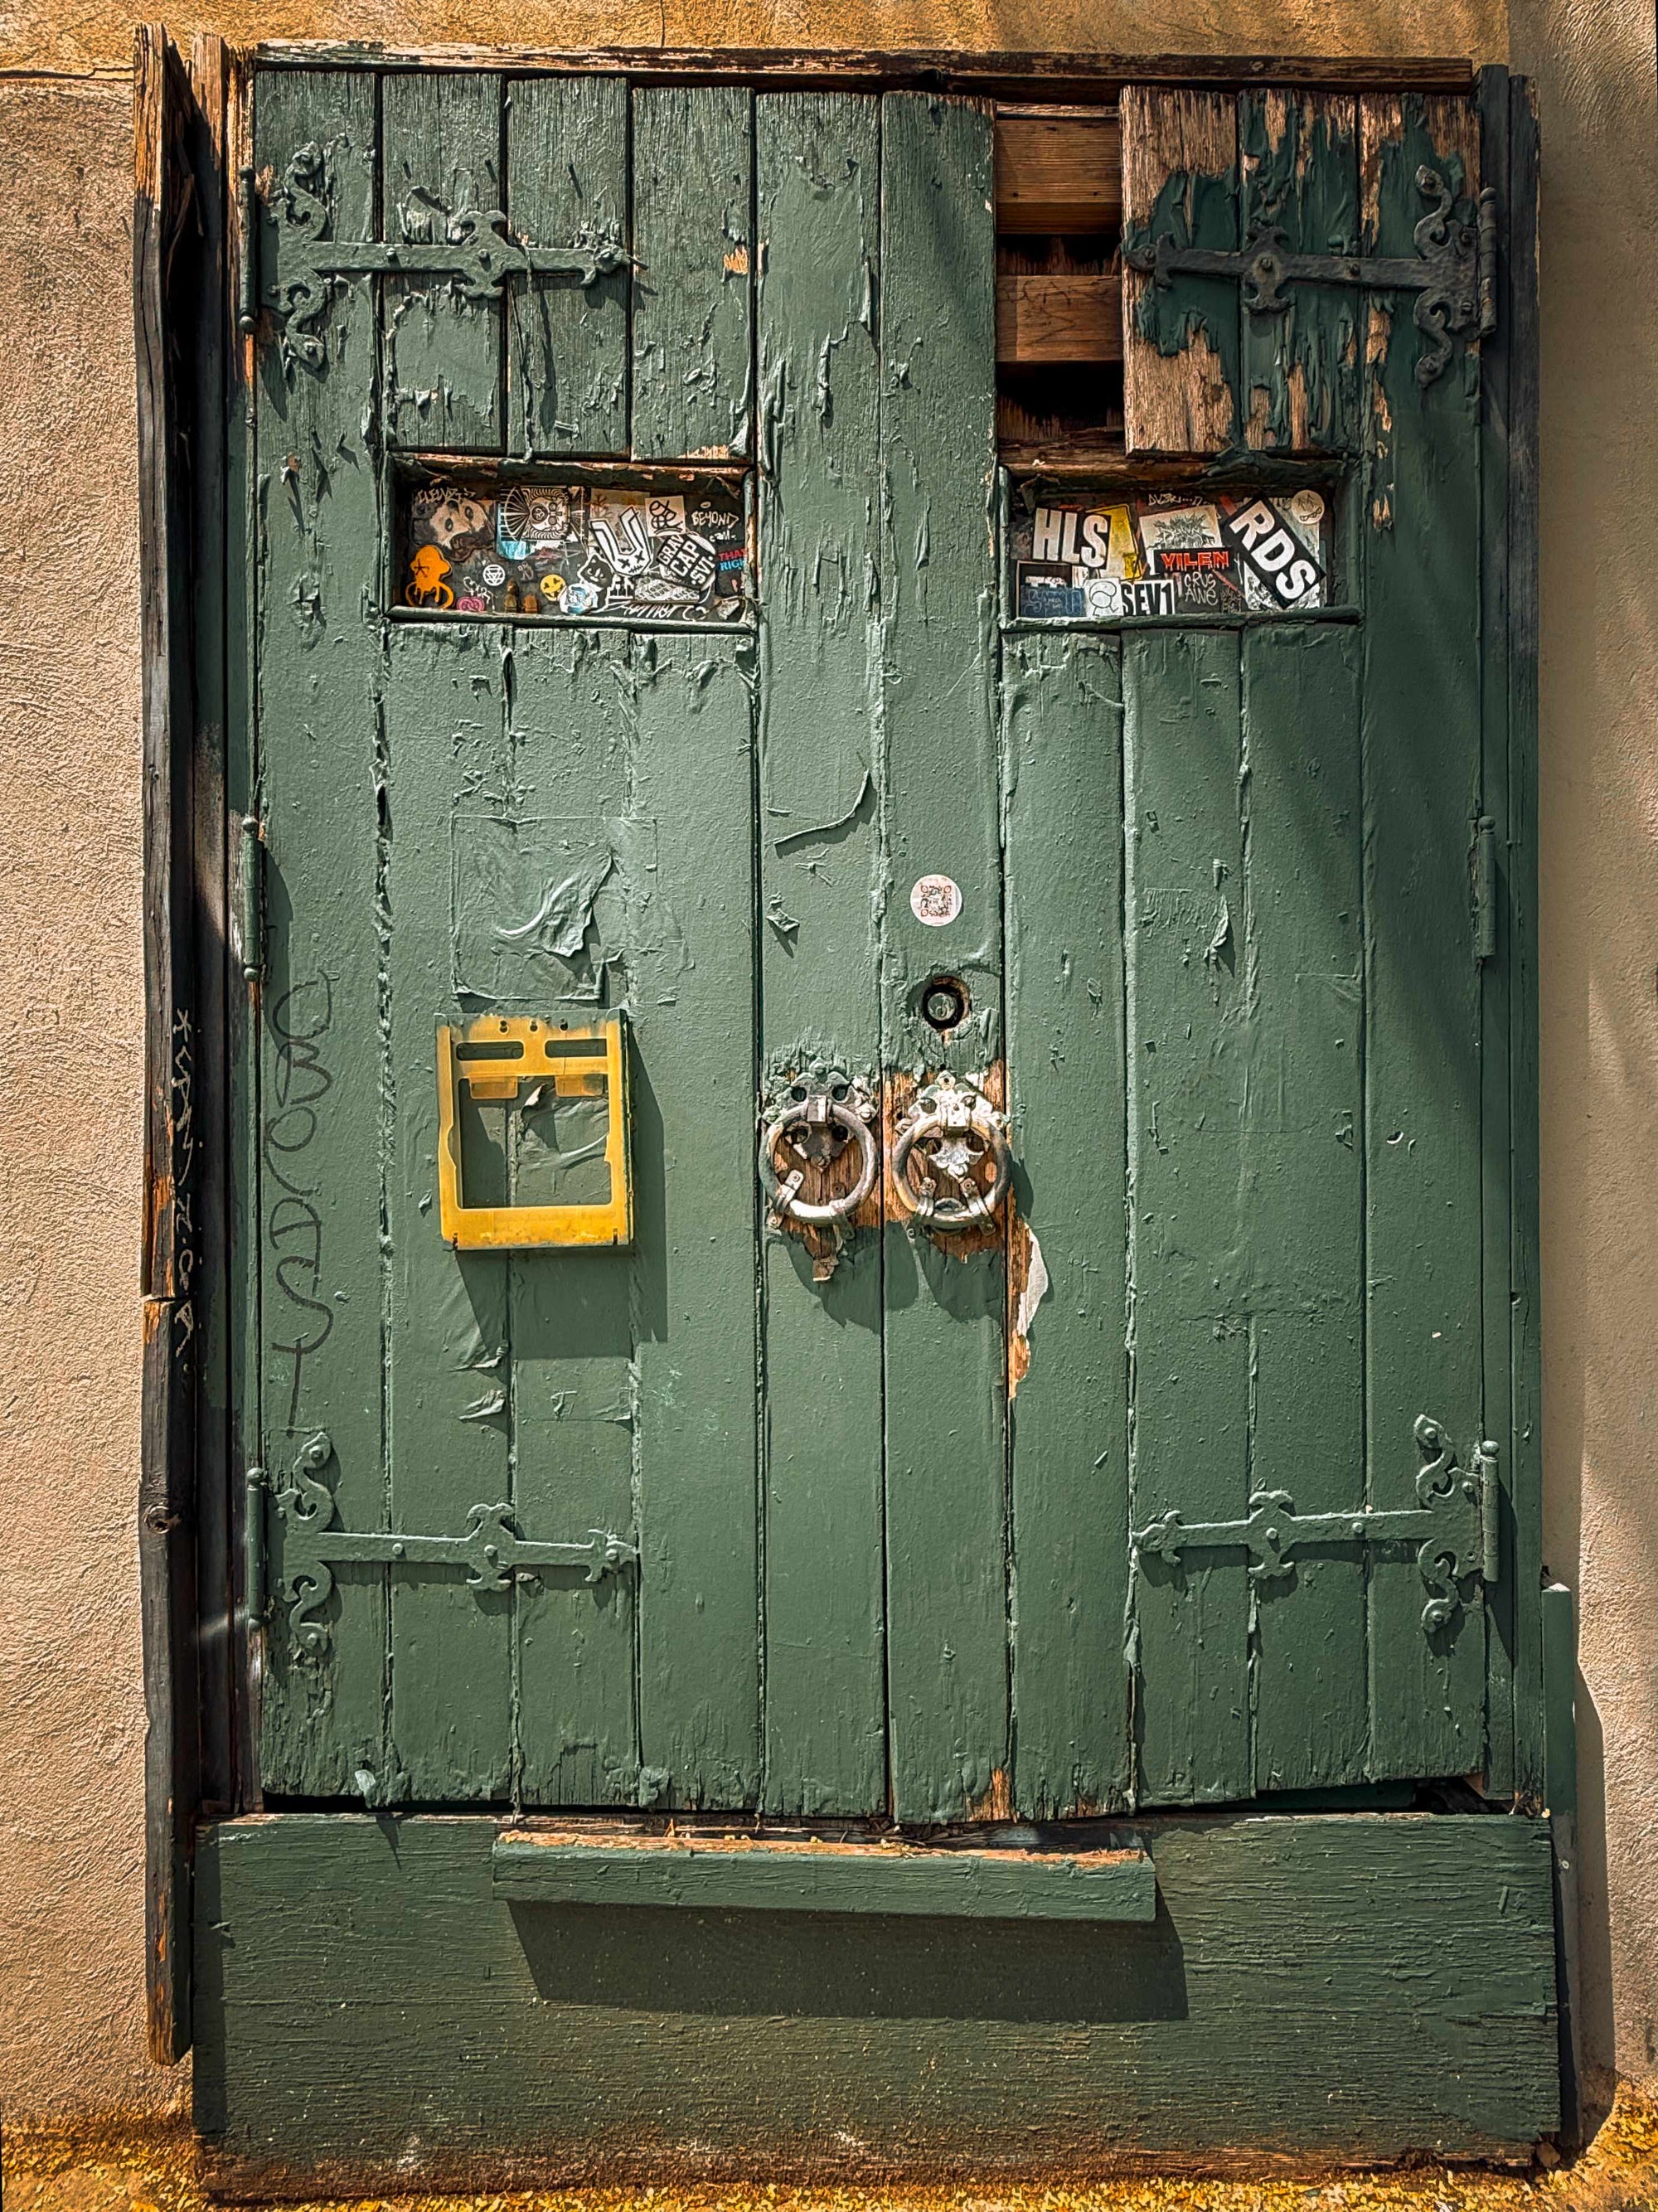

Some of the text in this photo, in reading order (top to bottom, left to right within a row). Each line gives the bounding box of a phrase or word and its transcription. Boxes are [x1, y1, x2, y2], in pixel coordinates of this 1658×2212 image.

[691, 510, 739, 529] BEYOND
[657, 534, 685, 565] GRAV
[1032, 507, 1108, 569] HLS
[1229, 499, 1316, 600] RDS
[670, 540, 701, 577] CAP
[1161, 551, 1229, 570] VILEN
